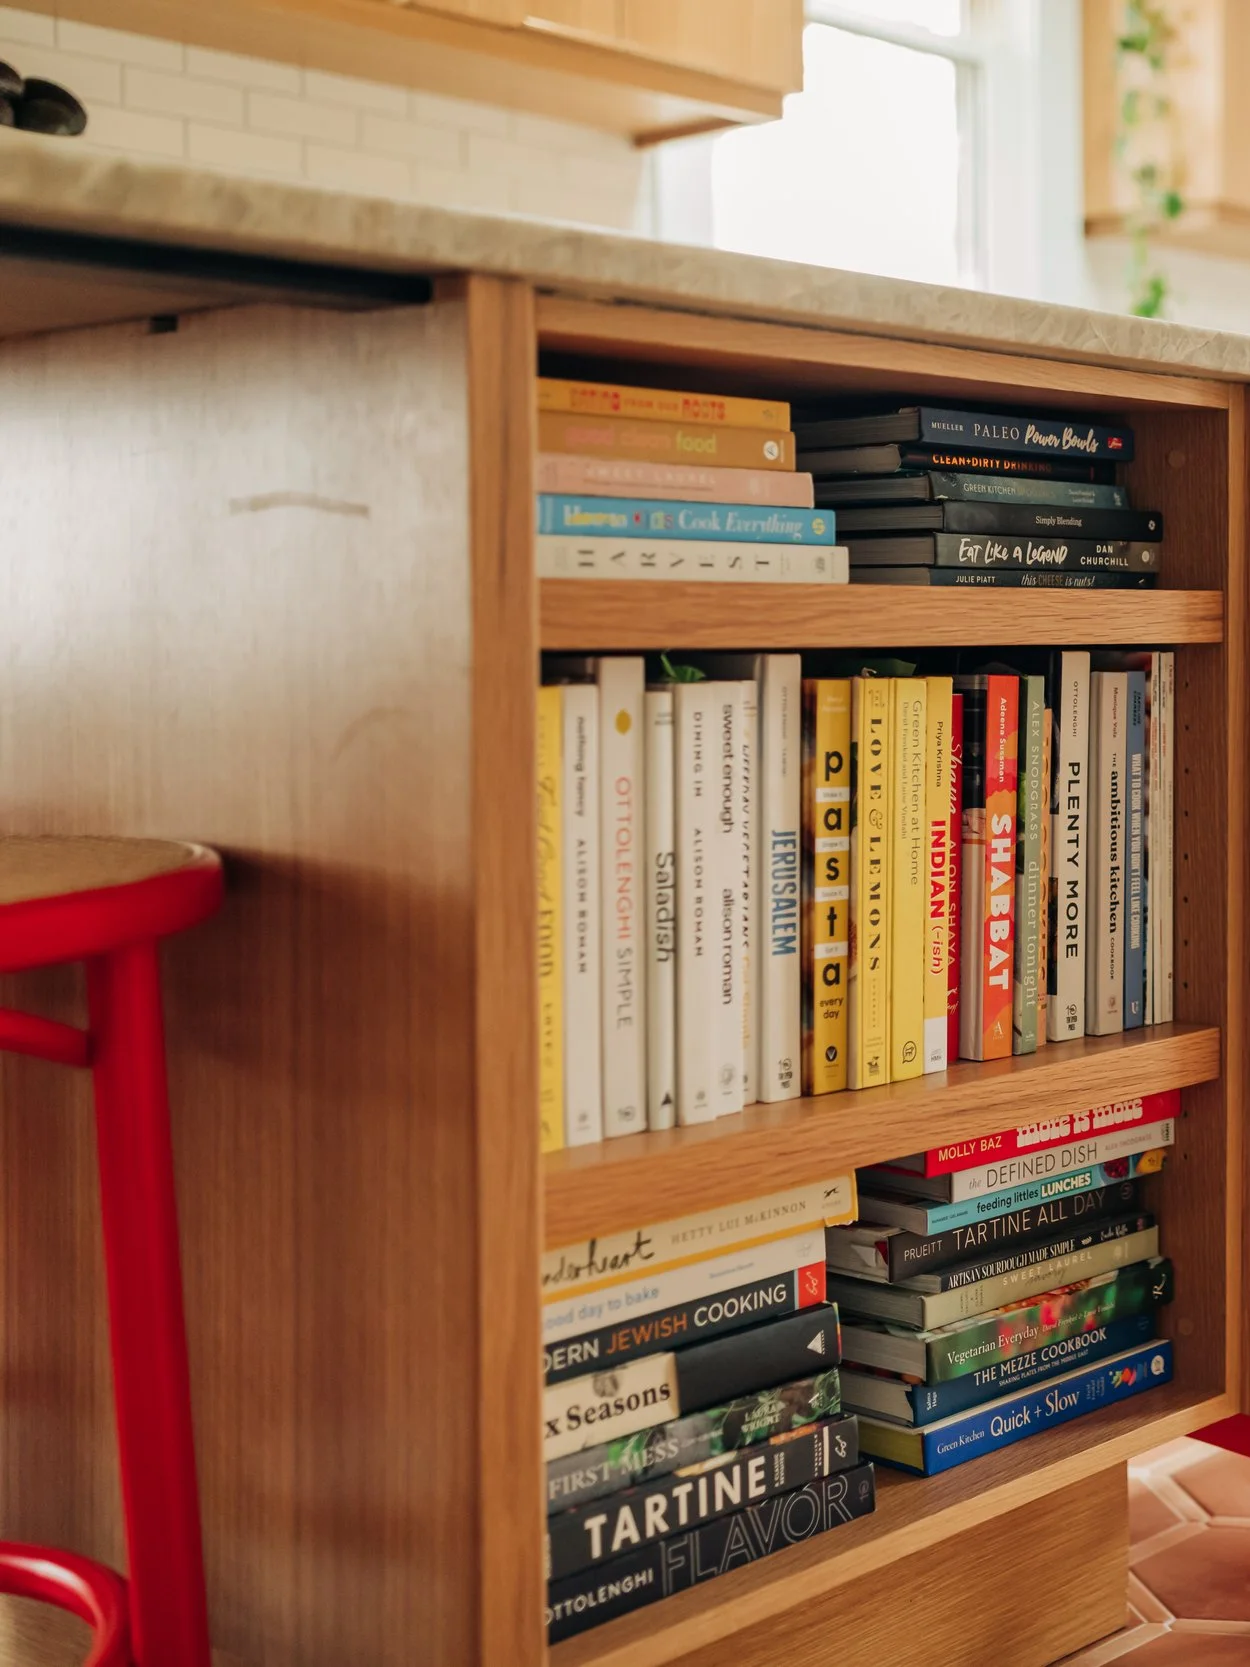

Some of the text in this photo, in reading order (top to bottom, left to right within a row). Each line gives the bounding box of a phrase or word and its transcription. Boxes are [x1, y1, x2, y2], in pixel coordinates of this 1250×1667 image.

[931, 421, 964, 432] MUELLER
[973, 423, 1020, 440] PALEO
[1024, 423, 1060, 449] Power
[1062, 426, 1099, 453] Bowls
[963, 483, 1016, 495] GREEN KITCHEN
[1003, 459, 1053, 473] DRINKING
[679, 509, 721, 532] Cook
[726, 512, 803, 542] Everything
[1035, 515, 1083, 527] Simply Blending
[1012, 546, 1022, 563] A
[1080, 556, 1129, 567] CHURCHILL
[1096, 544, 1114, 554] DAN
[955, 575, 996, 584] JULIE PIATT
[1020, 573, 1095, 587] this CHEESE is nuts!
[869, 718, 883, 801] LOVE
[935, 721, 944, 788] Priya Krishna
[998, 697, 1007, 783] Adeena Sussman
[1131, 753, 1141, 776] WHAT
[910, 701, 923, 886] Green Kitchen at Home
[1131, 778, 1141, 788] TO
[1131, 789, 1141, 811] COOK
[692, 711, 704, 958] DINING IN ALISON ROMAN
[1109, 770, 1121, 862] ambitious
[1131, 812, 1141, 834] WHEN
[719, 703, 735, 1006] sweet enough alison roman
[949, 840, 957, 893] ALON
[1023, 700, 1040, 1008] ALEX SNODGRASS dinner tonight
[1065, 762, 1081, 959] PLENTY MORE
[614, 776, 634, 1030] OTTOLENGHI SIMPLE
[655, 851, 676, 963] Saladish
[771, 830, 798, 956] JERUSALEM
[868, 836, 882, 971] LEMONS
[930, 820, 946, 975] INDIAN (-ish)
[988, 813, 1012, 990] SHABBAT
[1109, 866, 1121, 934] kitchen
[1131, 877, 1141, 895] FEEL
[1131, 896, 1141, 913] LIKE
[947, 902, 957, 966] SHAYA
[1131, 914, 1141, 949] COOKING
[819, 996, 844, 1009] every
[823, 1008, 840, 1020] day
[938, 1141, 976, 1162] MOLLY
[980, 1136, 1002, 1152] BAZ
[968, 1177, 982, 1190] the
[986, 1149, 1056, 1189] DEFINED
[1061, 1142, 1098, 1168] DISH
[976, 1173, 1092, 1214] feeding littles LUNCHES
[671, 1224, 714, 1245] HETTY
[904, 1239, 943, 1262] PRUEITT
[952, 1209, 1031, 1250] TARTINE
[1037, 1202, 1068, 1226] ALL
[1073, 1190, 1105, 1215] DAY
[948, 1238, 1076, 1289] ARTISAN SOURDOUGH MADE SIMPLE
[1002, 1252, 1093, 1286] SWEET LAUREL
[606, 1312, 687, 1355] JEWISH
[694, 1283, 787, 1328] COOKING
[607, 1296, 622, 1311] to
[624, 1287, 660, 1307] bake
[947, 1325, 1039, 1365] Vegetarian Everyday
[974, 1327, 1107, 1386] THE MEZZE COOKBOOK
[999, 1375, 1020, 1386] SHARING
[1021, 1369, 1037, 1381] PLATES
[1038, 1364, 1051, 1375] FROM
[1051, 1360, 1060, 1369] THE
[1060, 1354, 1077, 1366] MIDDLE
[566, 1382, 671, 1432] Seasons
[937, 1390, 1080, 1454] Green Kitchen Quick + Slow
[549, 1438, 680, 1499] FIRST MESS
[583, 1455, 766, 1560] TARTINE
[660, 1475, 854, 1597] FLAVOR
[544, 1567, 654, 1626] OTTOLENGHI
